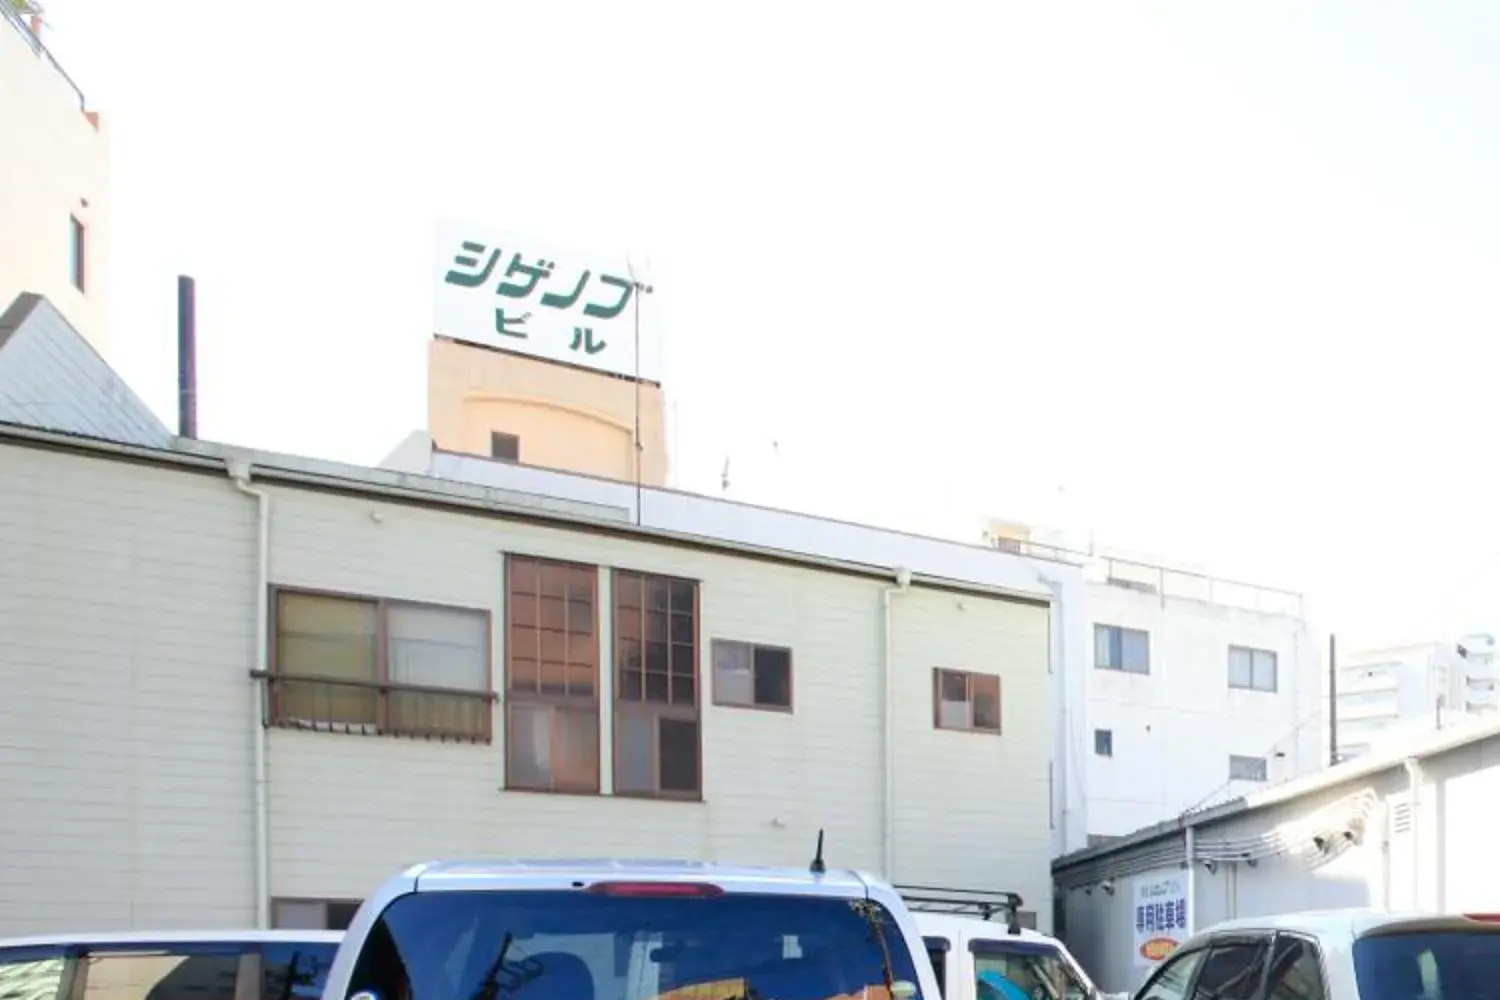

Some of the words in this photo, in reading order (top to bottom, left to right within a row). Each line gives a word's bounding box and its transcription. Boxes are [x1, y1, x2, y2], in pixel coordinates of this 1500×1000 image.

[445, 240, 653, 319] シゲノブ
[495, 307, 608, 354] ビル
